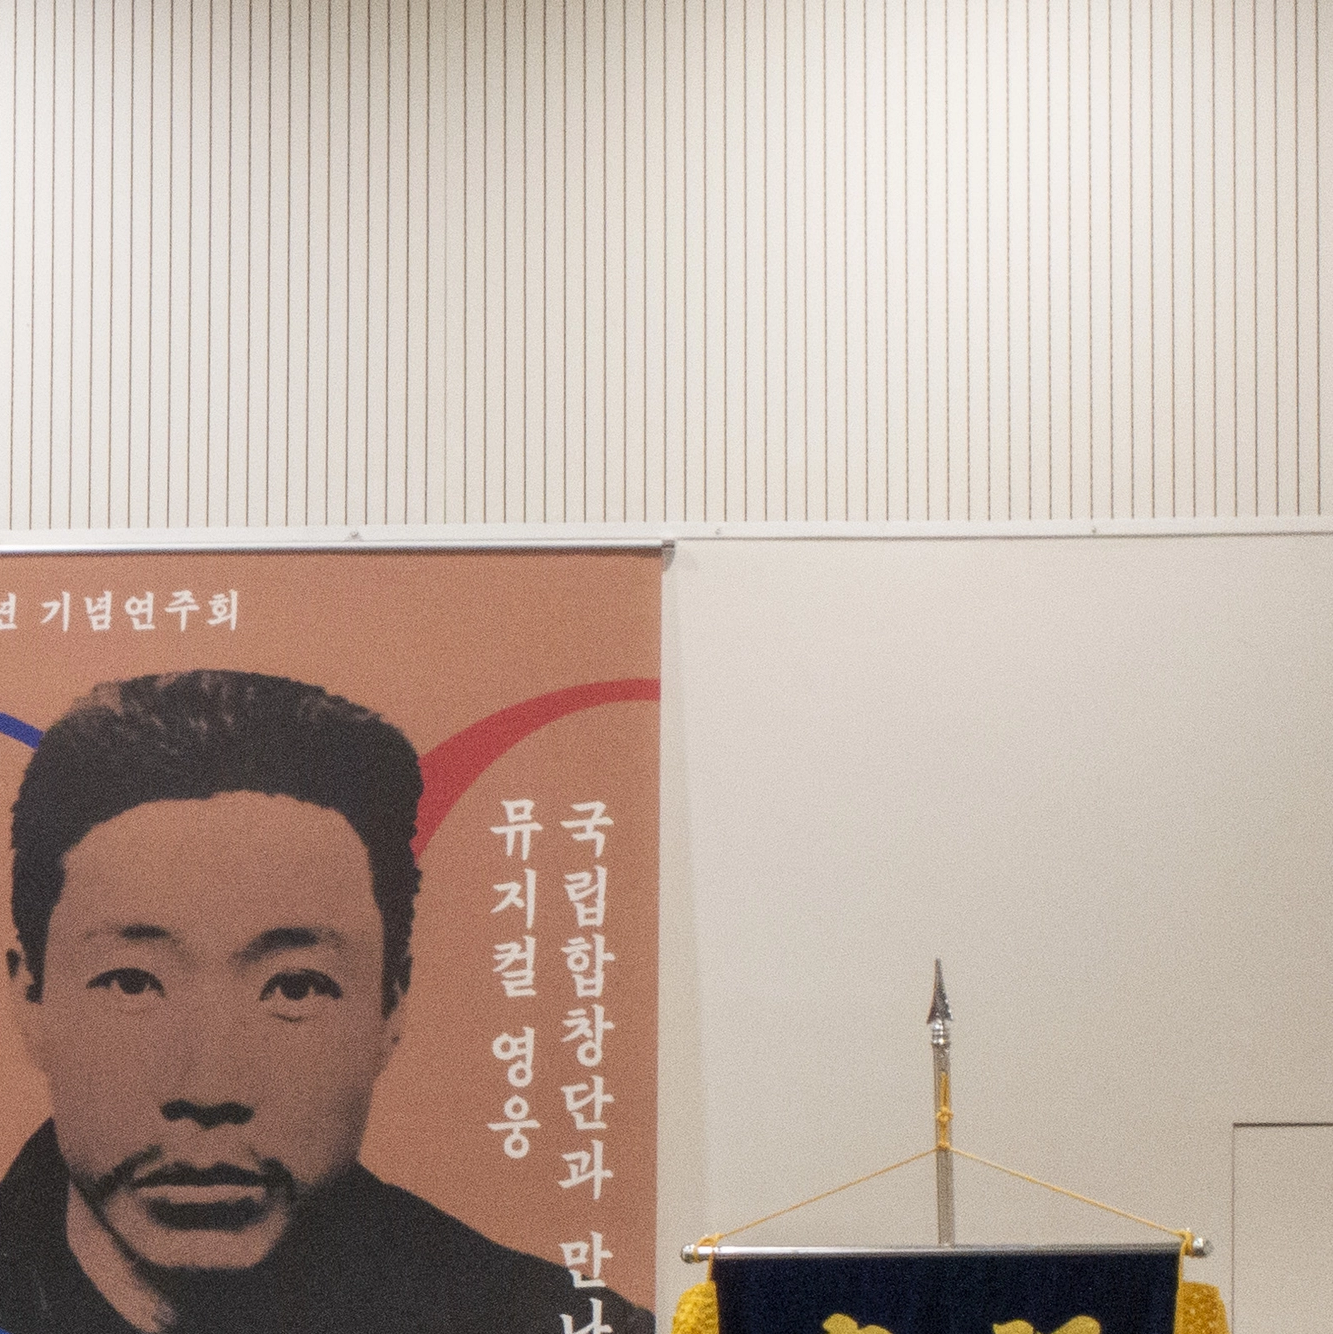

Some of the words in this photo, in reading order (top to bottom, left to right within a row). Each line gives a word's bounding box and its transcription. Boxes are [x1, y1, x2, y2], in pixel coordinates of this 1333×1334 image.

[40, 589, 239, 633] 기념연주회
[489, 798, 544, 999] 뮤지컬
[558, 800, 616, 1201] 국립합창단과
[487, 1025, 542, 1160] 영웅
